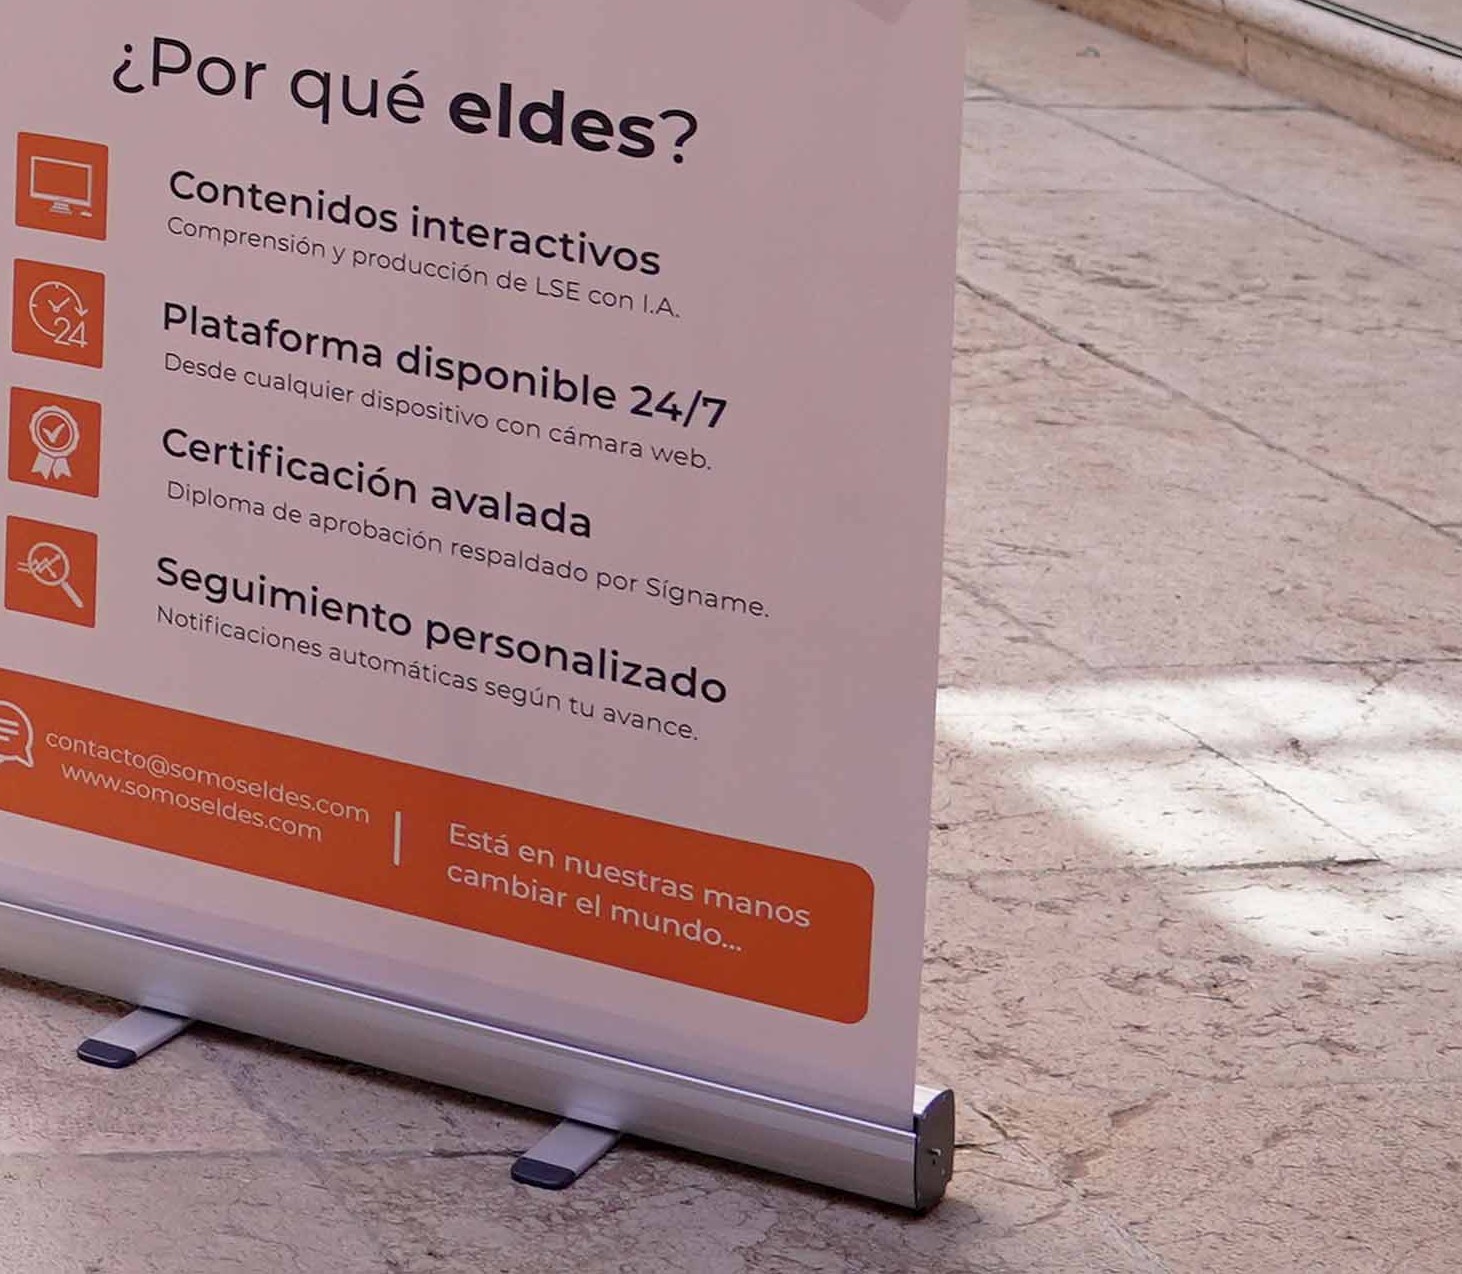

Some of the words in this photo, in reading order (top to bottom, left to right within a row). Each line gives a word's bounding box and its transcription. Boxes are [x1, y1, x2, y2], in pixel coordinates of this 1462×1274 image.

[113, 37, 266, 100] ¿Por
[291, 70, 424, 124] qué
[449, 83, 697, 163] eldes?
[168, 217, 325, 257] Comprensión
[332, 246, 345, 264] y
[353, 250, 487, 285] producción
[497, 271, 527, 292] de
[537, 277, 580, 301] LSE
[589, 290, 633, 310] con
[644, 295, 679, 317] I.A.
[170, 171, 397, 232] Contenidos
[413, 205, 660, 275] interactivos
[164, 302, 381, 368] Plataforma
[397, 345, 616, 409] disponible
[631, 386, 726, 427] 24/7
[165, 353, 236, 381] Desde
[244, 372, 354, 402] cualquier
[361, 389, 488, 428] dispositivo
[496, 418, 540, 438] con
[549, 426, 642, 457] cámara
[652, 447, 712, 471] web.
[163, 429, 415, 503] Certificación
[432, 487, 590, 538] avalada
[168, 481, 264, 516] Diploma
[273, 503, 301, 523] de
[309, 513, 441, 552] aprobación
[452, 543, 587, 582] respaldado
[597, 572, 638, 591] por
[646, 578, 768, 617] Sígname.
[157, 557, 411, 635] Seguimiento
[427, 620, 726, 702] personalizado
[158, 605, 322, 657] Notificaciones
[329, 647, 477, 692] automáticas
[485, 681, 560, 710] según
[569, 697, 594, 717] tu
[604, 708, 697, 740] avance.
[46, 733, 369, 823] contacto@somoseldes.com
[62, 764, 321, 842] www.somoseldes.com
[448, 866, 567, 908] cambiar
[576, 895, 600, 916] el
[612, 905, 741, 951] mundo...
[450, 823, 508, 857] Está
[519, 845, 554, 868] en
[565, 856, 693, 900] nuestras
[704, 889, 810, 927] manos
